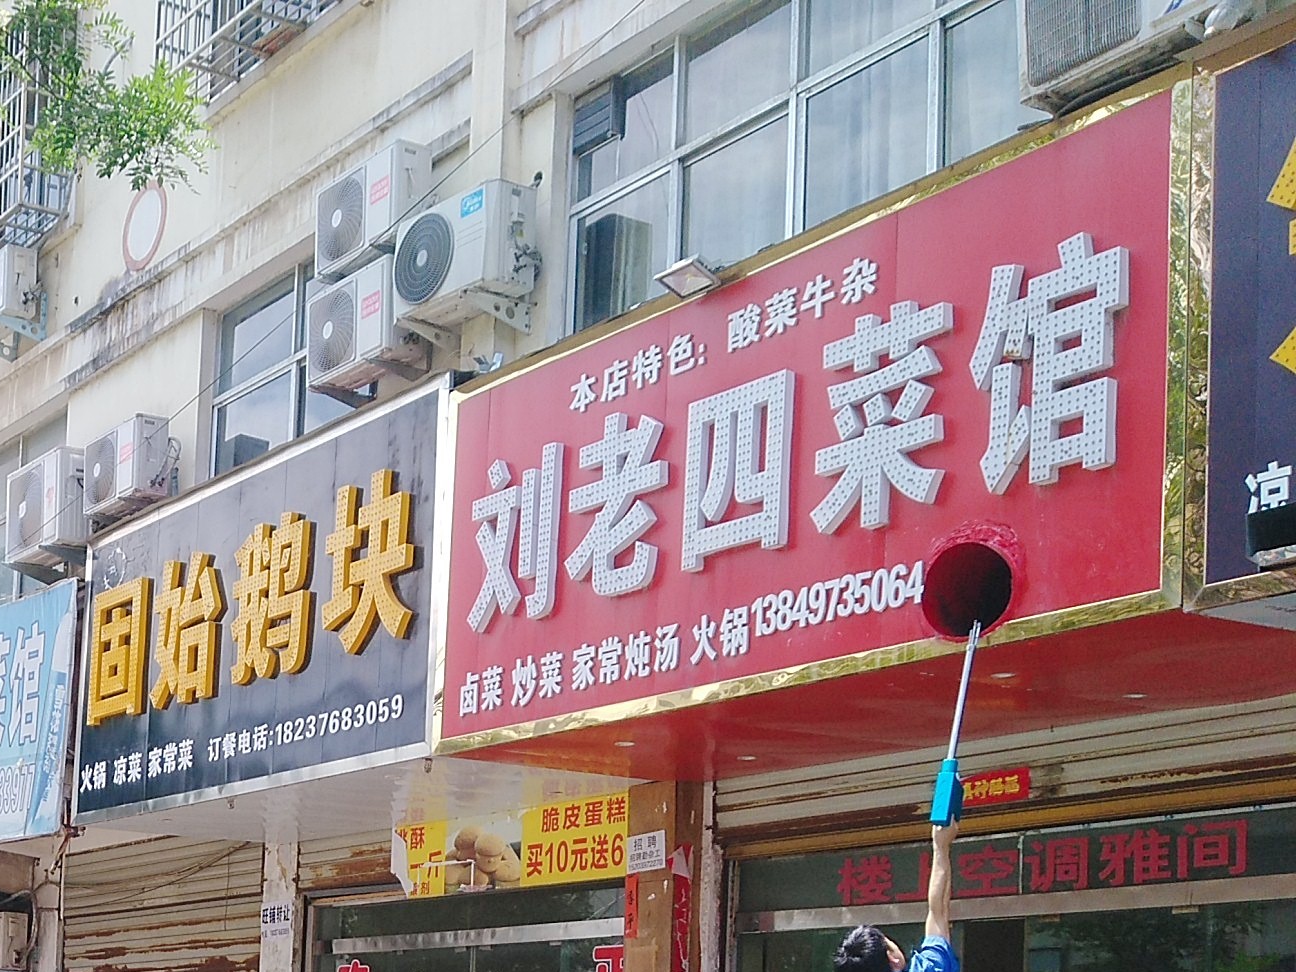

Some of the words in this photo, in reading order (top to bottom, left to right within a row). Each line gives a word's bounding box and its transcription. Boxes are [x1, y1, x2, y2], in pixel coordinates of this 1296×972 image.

[466, 231, 1130, 633] 刘老四菜馆
[87, 469, 415, 726] 固始鹅块
[458, 663, 504, 716] 卤菜
[510, 650, 563, 707] 炒菜
[570, 622, 681, 692] 家常炖汤
[689, 605, 750, 667] 火锅
[751, 559, 926, 639] 13849735064
[80, 760, 107, 793] 火锅
[113, 755, 141, 785] 凉菜
[148, 739, 195, 779] 家常菜
[541, 796, 626, 833] 脆皮蛋糕
[526, 833, 624, 878] 买10元送6
[634, 834, 657, 852] 招聘
